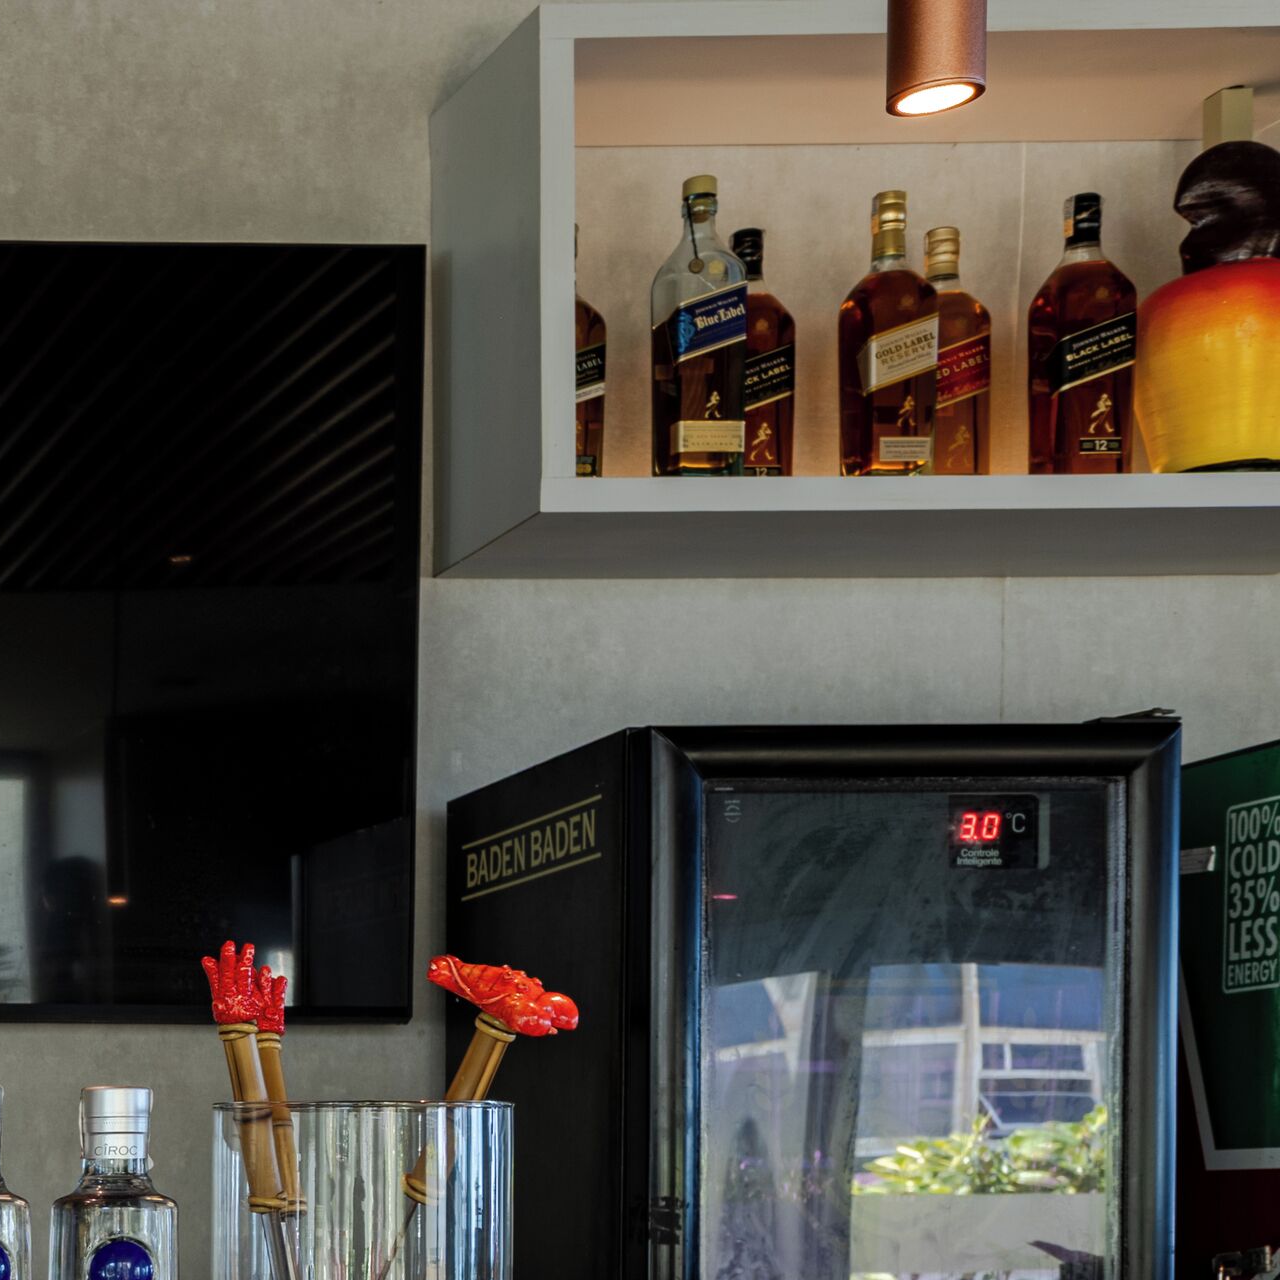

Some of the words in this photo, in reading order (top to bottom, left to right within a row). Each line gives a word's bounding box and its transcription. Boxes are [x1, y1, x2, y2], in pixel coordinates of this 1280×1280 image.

[694, 315, 719, 331] Blue
[719, 303, 746, 322] Label
[875, 345, 903, 360] GOLD
[903, 332, 936, 350] LABEL
[881, 342, 934, 366] RESERVE
[1065, 344, 1100, 361] BLACK
[1101, 333, 1134, 349] LABEL
[761, 364, 791, 380] LABEL
[936, 368, 950, 380] ED
[953, 354, 989, 373] LABEL
[1094, 440, 1108, 450] 12
[960, 812, 1001, 840] 3.0
[1230, 802, 1280, 844] 100%
[466, 834, 526, 889] BADEN
[530, 809, 596, 867] BADEN
[957, 857, 1002, 867] Inteligente
[961, 849, 1000, 857] Controle
[1230, 840, 1280, 879] COLD
[1229, 876, 1280, 919] 35%
[1229, 916, 1278, 961] LESS
[1228, 958, 1278, 986] ENERGY
[93, 1143, 138, 1156] CÎROC
